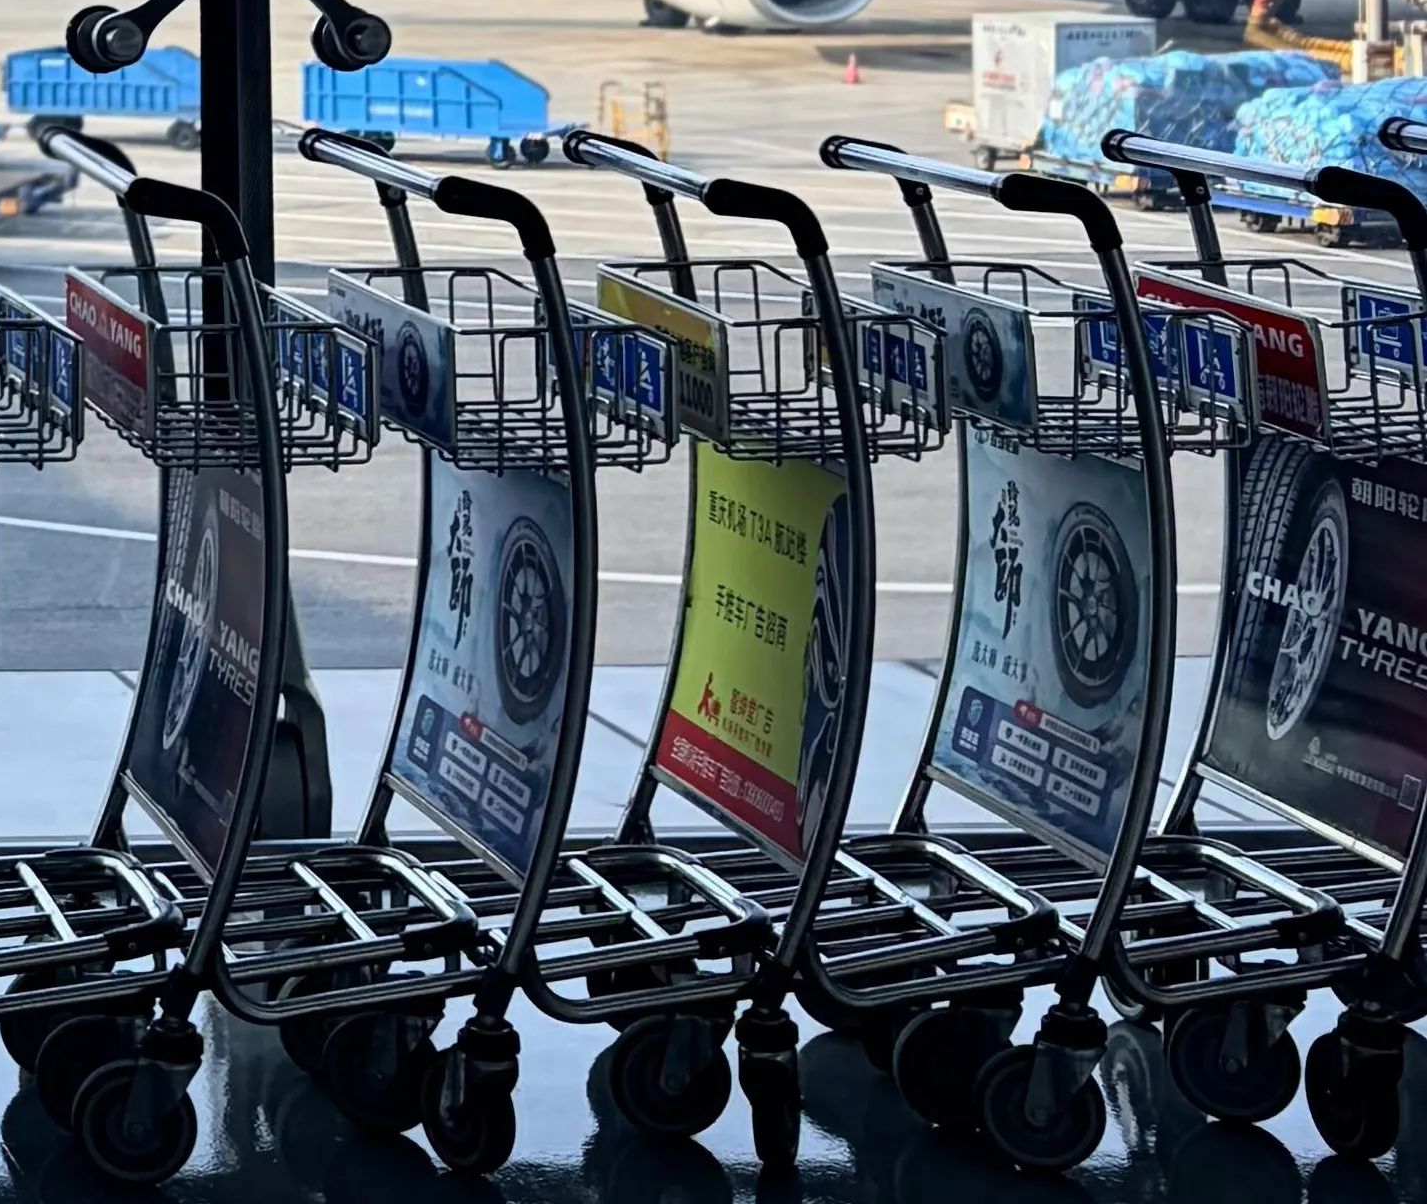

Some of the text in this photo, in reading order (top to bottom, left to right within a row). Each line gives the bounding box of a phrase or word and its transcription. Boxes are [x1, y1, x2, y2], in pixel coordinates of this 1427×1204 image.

[69, 291, 142, 359] CHAO YANG
[1245, 322, 1304, 358] ANG
[1351, 477, 1427, 523] 朝阳轮
[219, 620, 259, 676] YANG
[209, 647, 258, 707] TYRES
